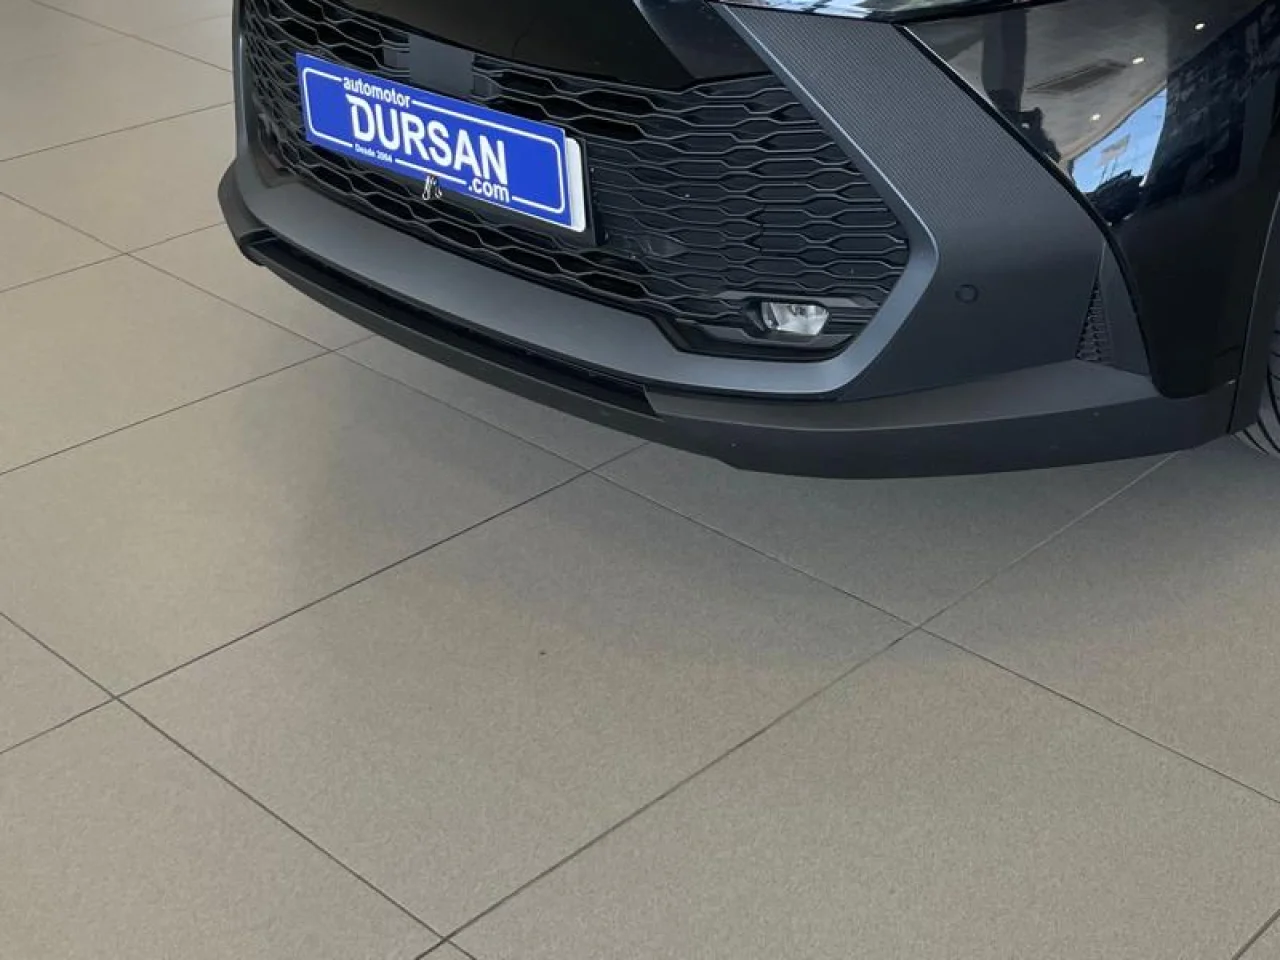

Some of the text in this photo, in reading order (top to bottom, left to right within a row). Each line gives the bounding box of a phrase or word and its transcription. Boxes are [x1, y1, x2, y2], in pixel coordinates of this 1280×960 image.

[343, 75, 411, 109] automotor
[345, 94, 508, 185] DURSAN
[468, 176, 510, 203] .com
